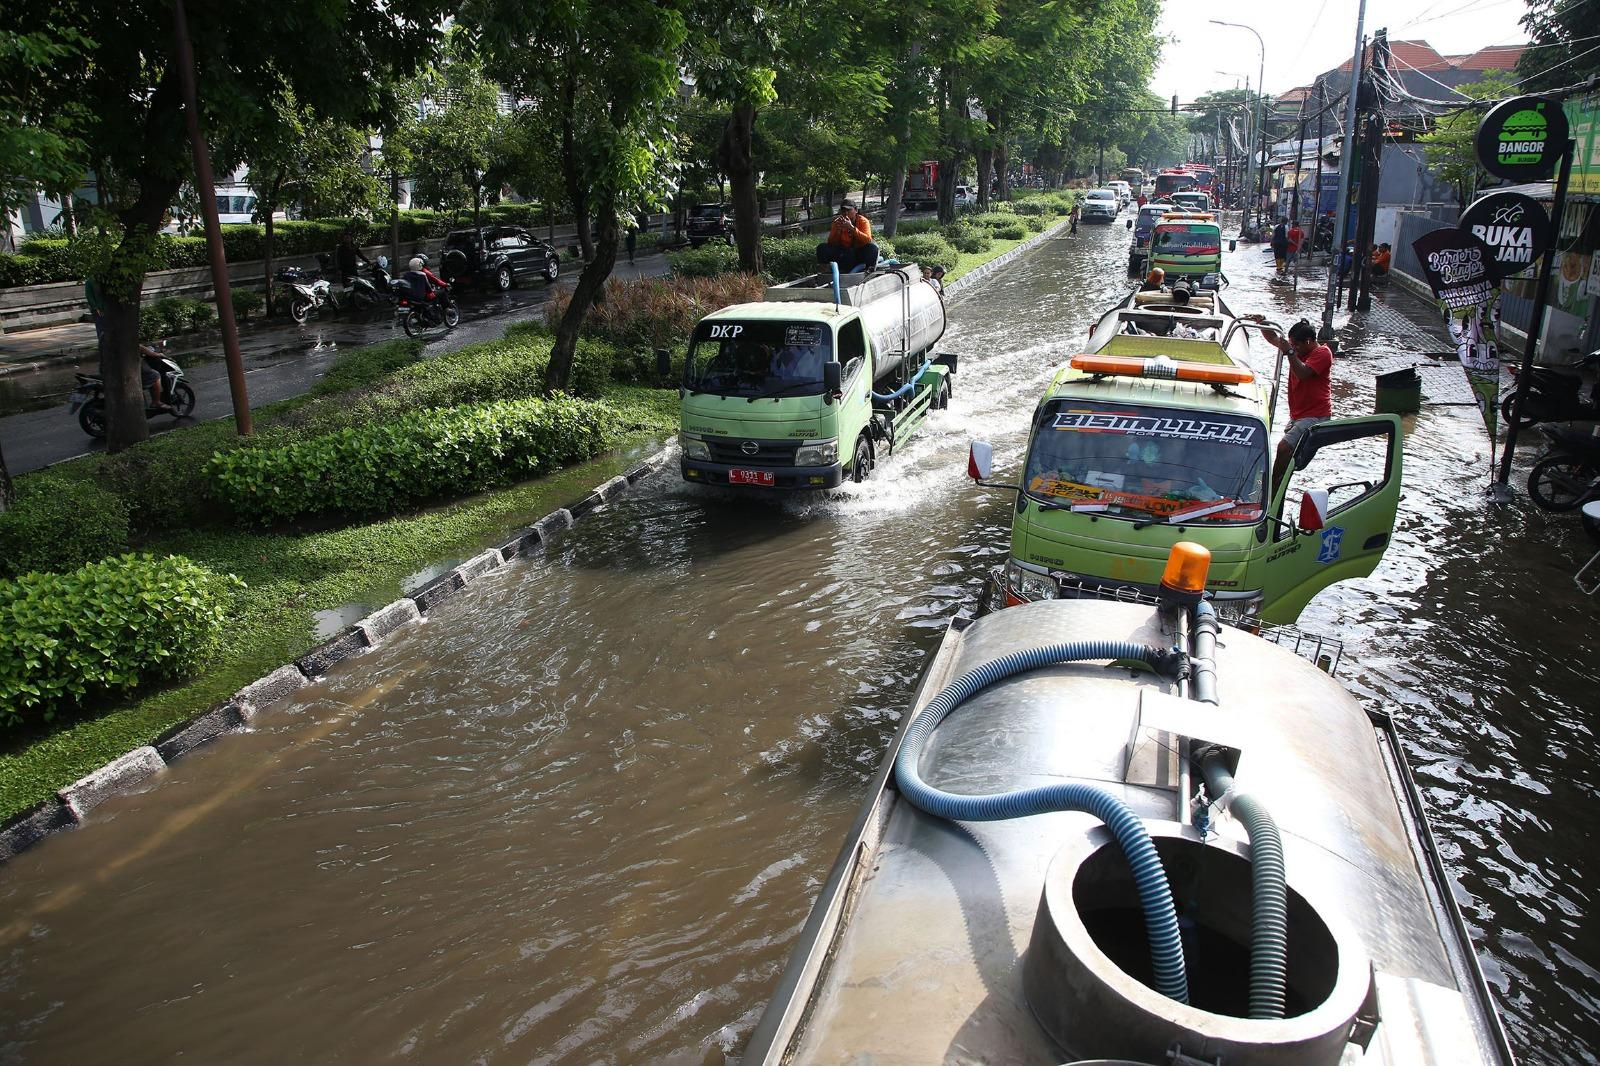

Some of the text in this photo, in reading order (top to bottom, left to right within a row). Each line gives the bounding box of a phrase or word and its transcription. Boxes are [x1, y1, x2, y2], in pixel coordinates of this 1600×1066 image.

[1499, 141, 1544, 153] BANGOR
[1472, 225, 1533, 247] BUKA
[1428, 247, 1481, 272] Burger
[1495, 247, 1533, 263] JAM
[1440, 260, 1485, 284] Bangor
[1438, 280, 1493, 299] BURGERNYA
[1445, 290, 1493, 308] INDONESIA
[710, 325, 743, 338] DKP
[730, 469, 736, 478] L
